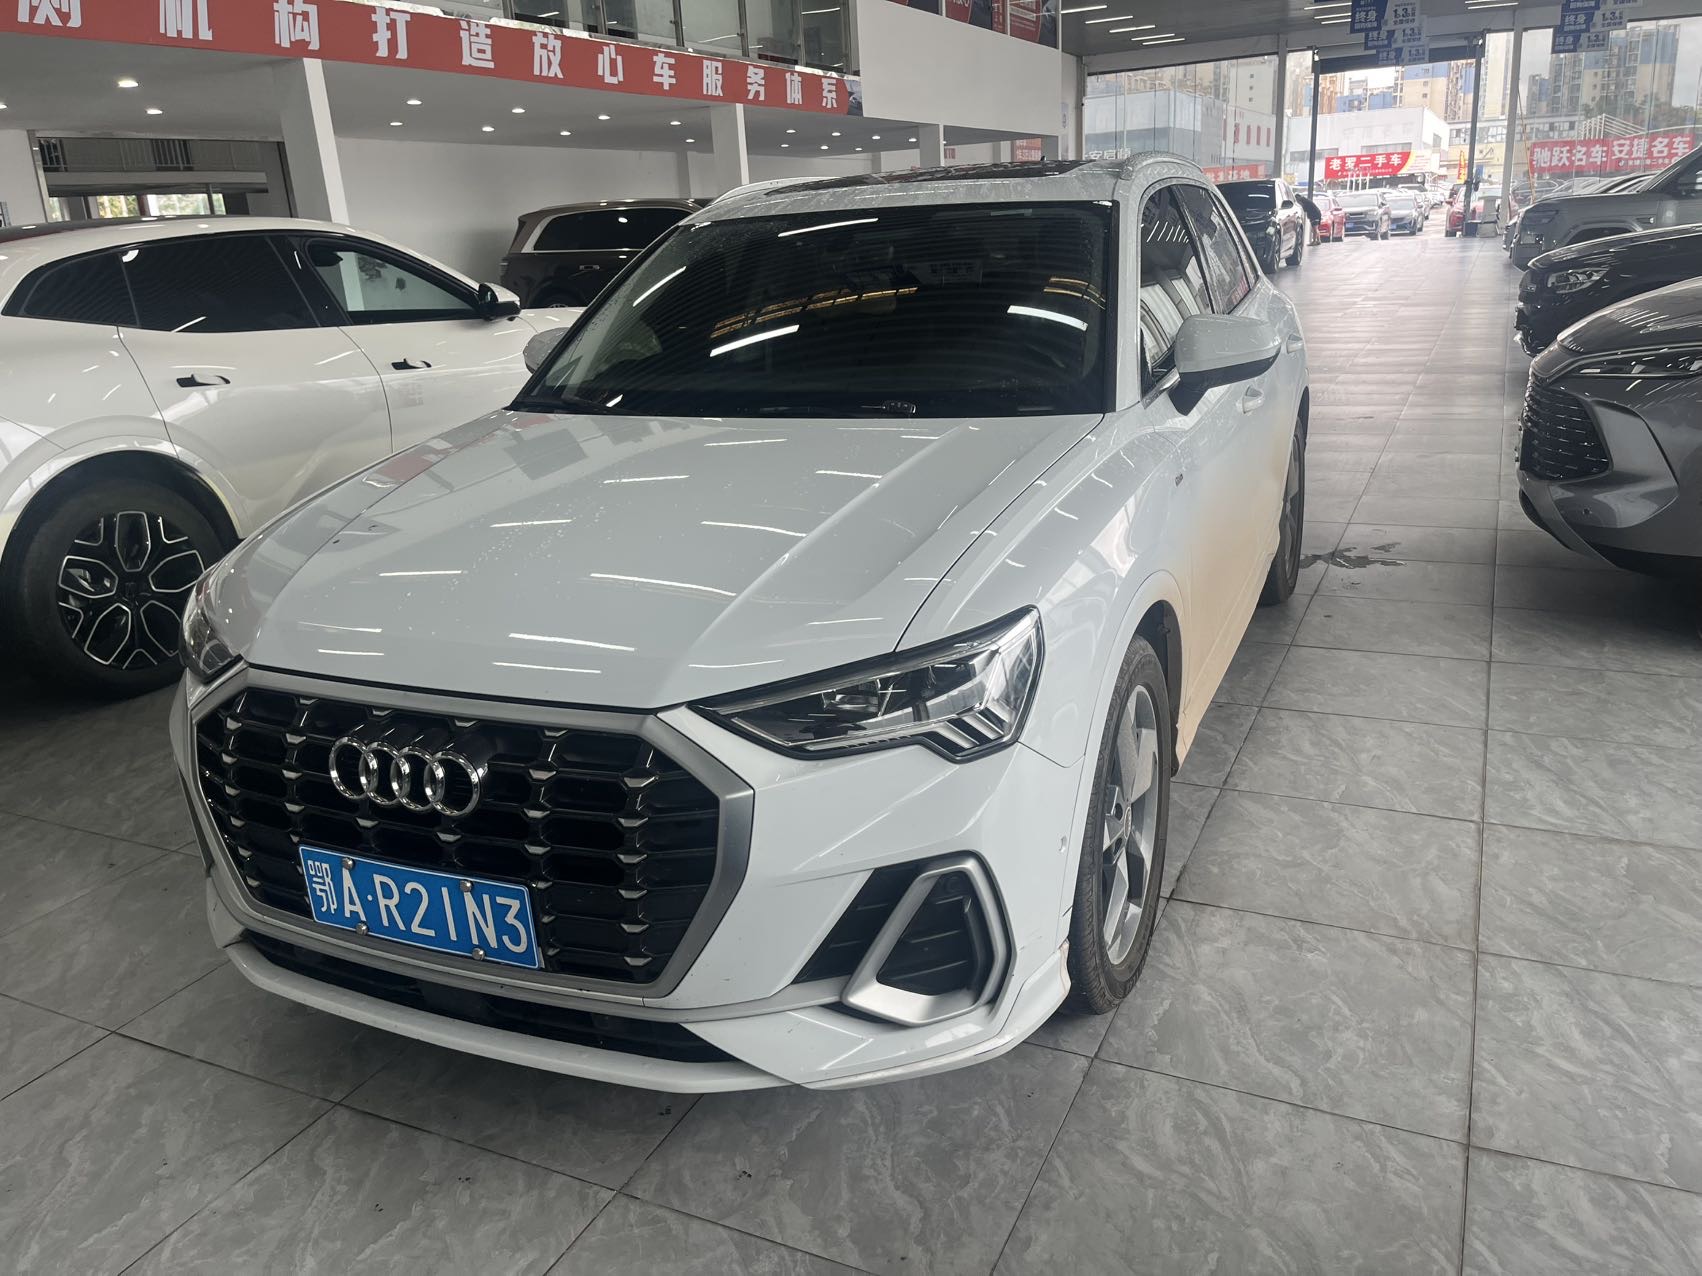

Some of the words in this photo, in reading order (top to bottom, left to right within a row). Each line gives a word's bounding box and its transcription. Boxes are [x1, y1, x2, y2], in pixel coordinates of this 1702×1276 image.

[1532, 145, 1608, 168] 驰跃名车
[1611, 136, 1691, 159] 安捷名车
[1329, 154, 1402, 170] 老罗二手车
[308, 860, 527, 953] 鄂A·R21N3
